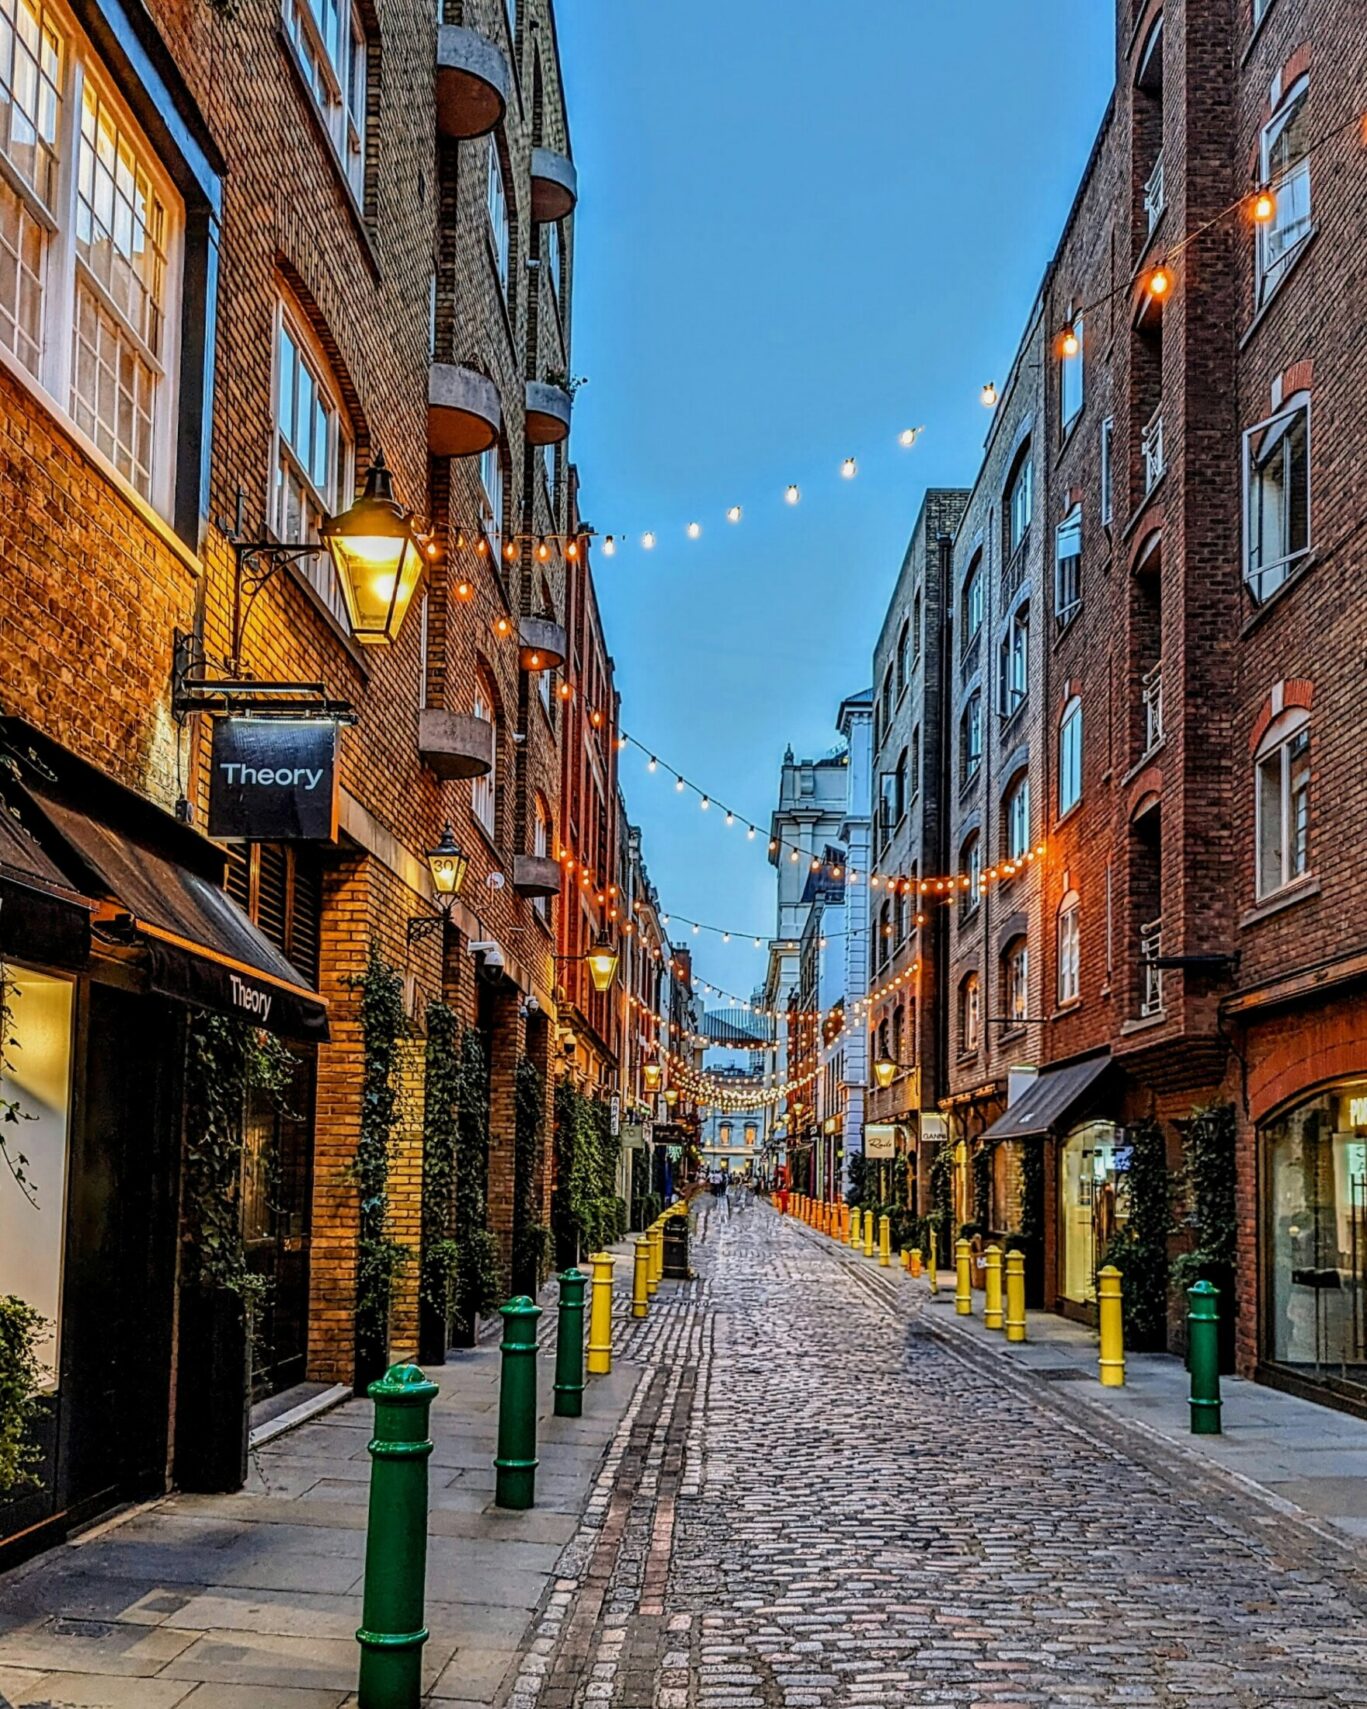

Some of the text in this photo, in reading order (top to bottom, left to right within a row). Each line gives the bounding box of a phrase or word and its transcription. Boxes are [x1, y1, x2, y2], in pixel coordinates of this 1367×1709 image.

[219, 763, 324, 790] Theory
[433, 859, 454, 872] 30
[229, 974, 272, 1022] Theory
